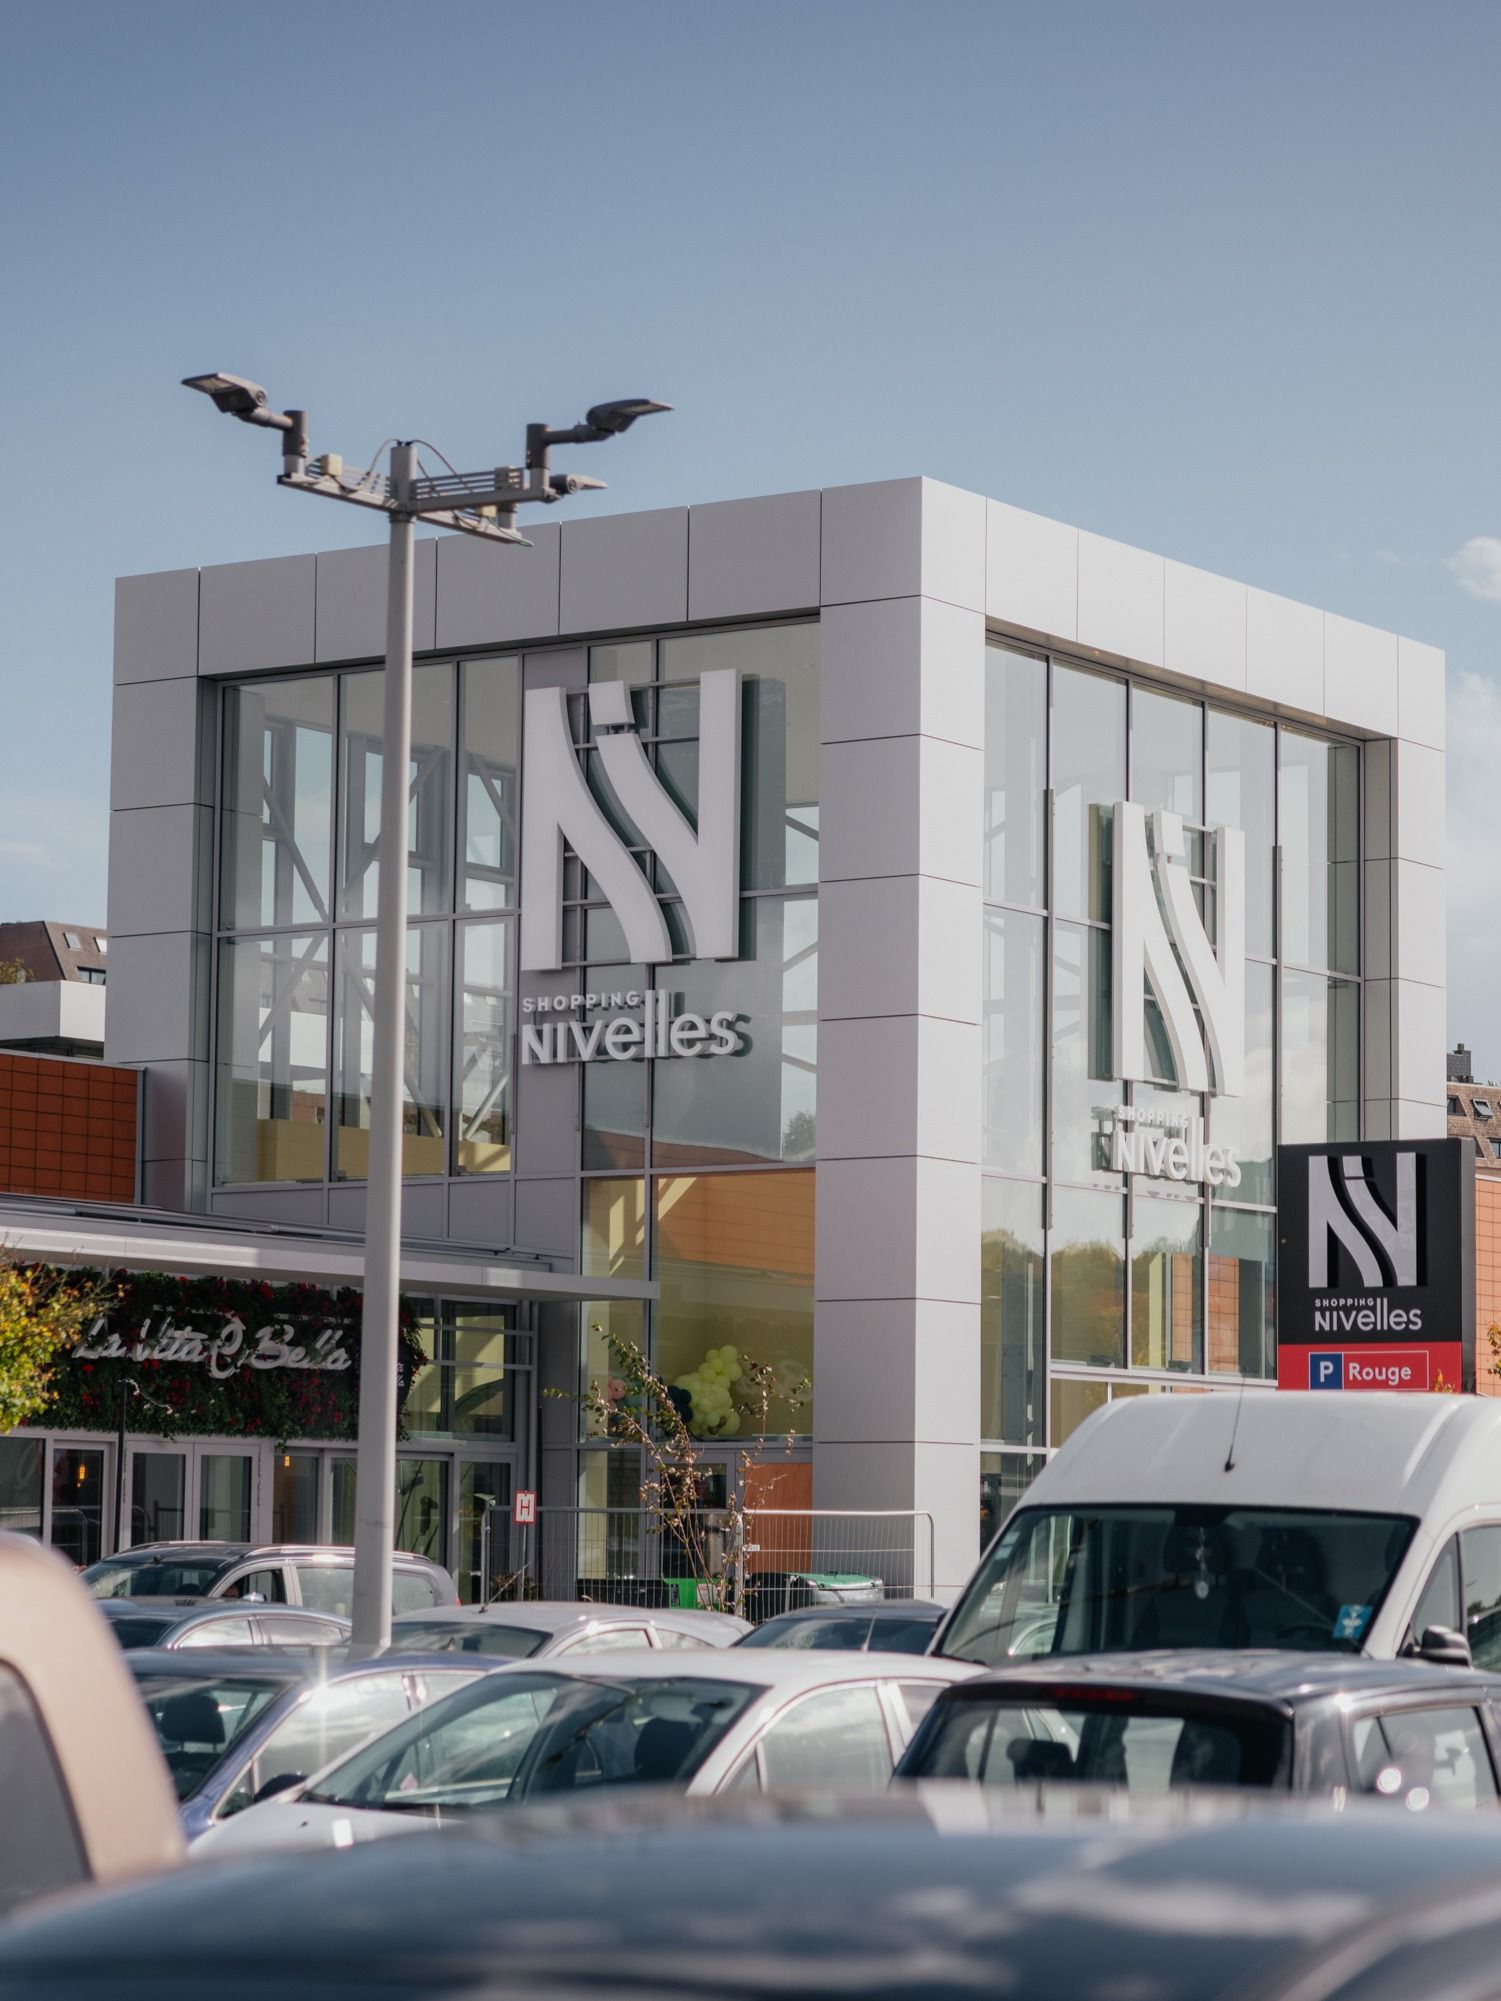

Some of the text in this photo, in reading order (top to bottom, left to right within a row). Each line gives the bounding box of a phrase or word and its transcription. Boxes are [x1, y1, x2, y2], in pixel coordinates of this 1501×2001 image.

[522, 990, 641, 1013] SHOPPING
[1117, 1104, 1189, 1128] SHOPPING
[1314, 1297, 1375, 1308] SHOPPING
[71, 1312, 127, 1360] La
[131, 1316, 209, 1362] Vita
[250, 1323, 353, 1370] Bella
[1320, 1361, 1412, 1386] P Rouge
[520, 1498, 531, 1517] H
